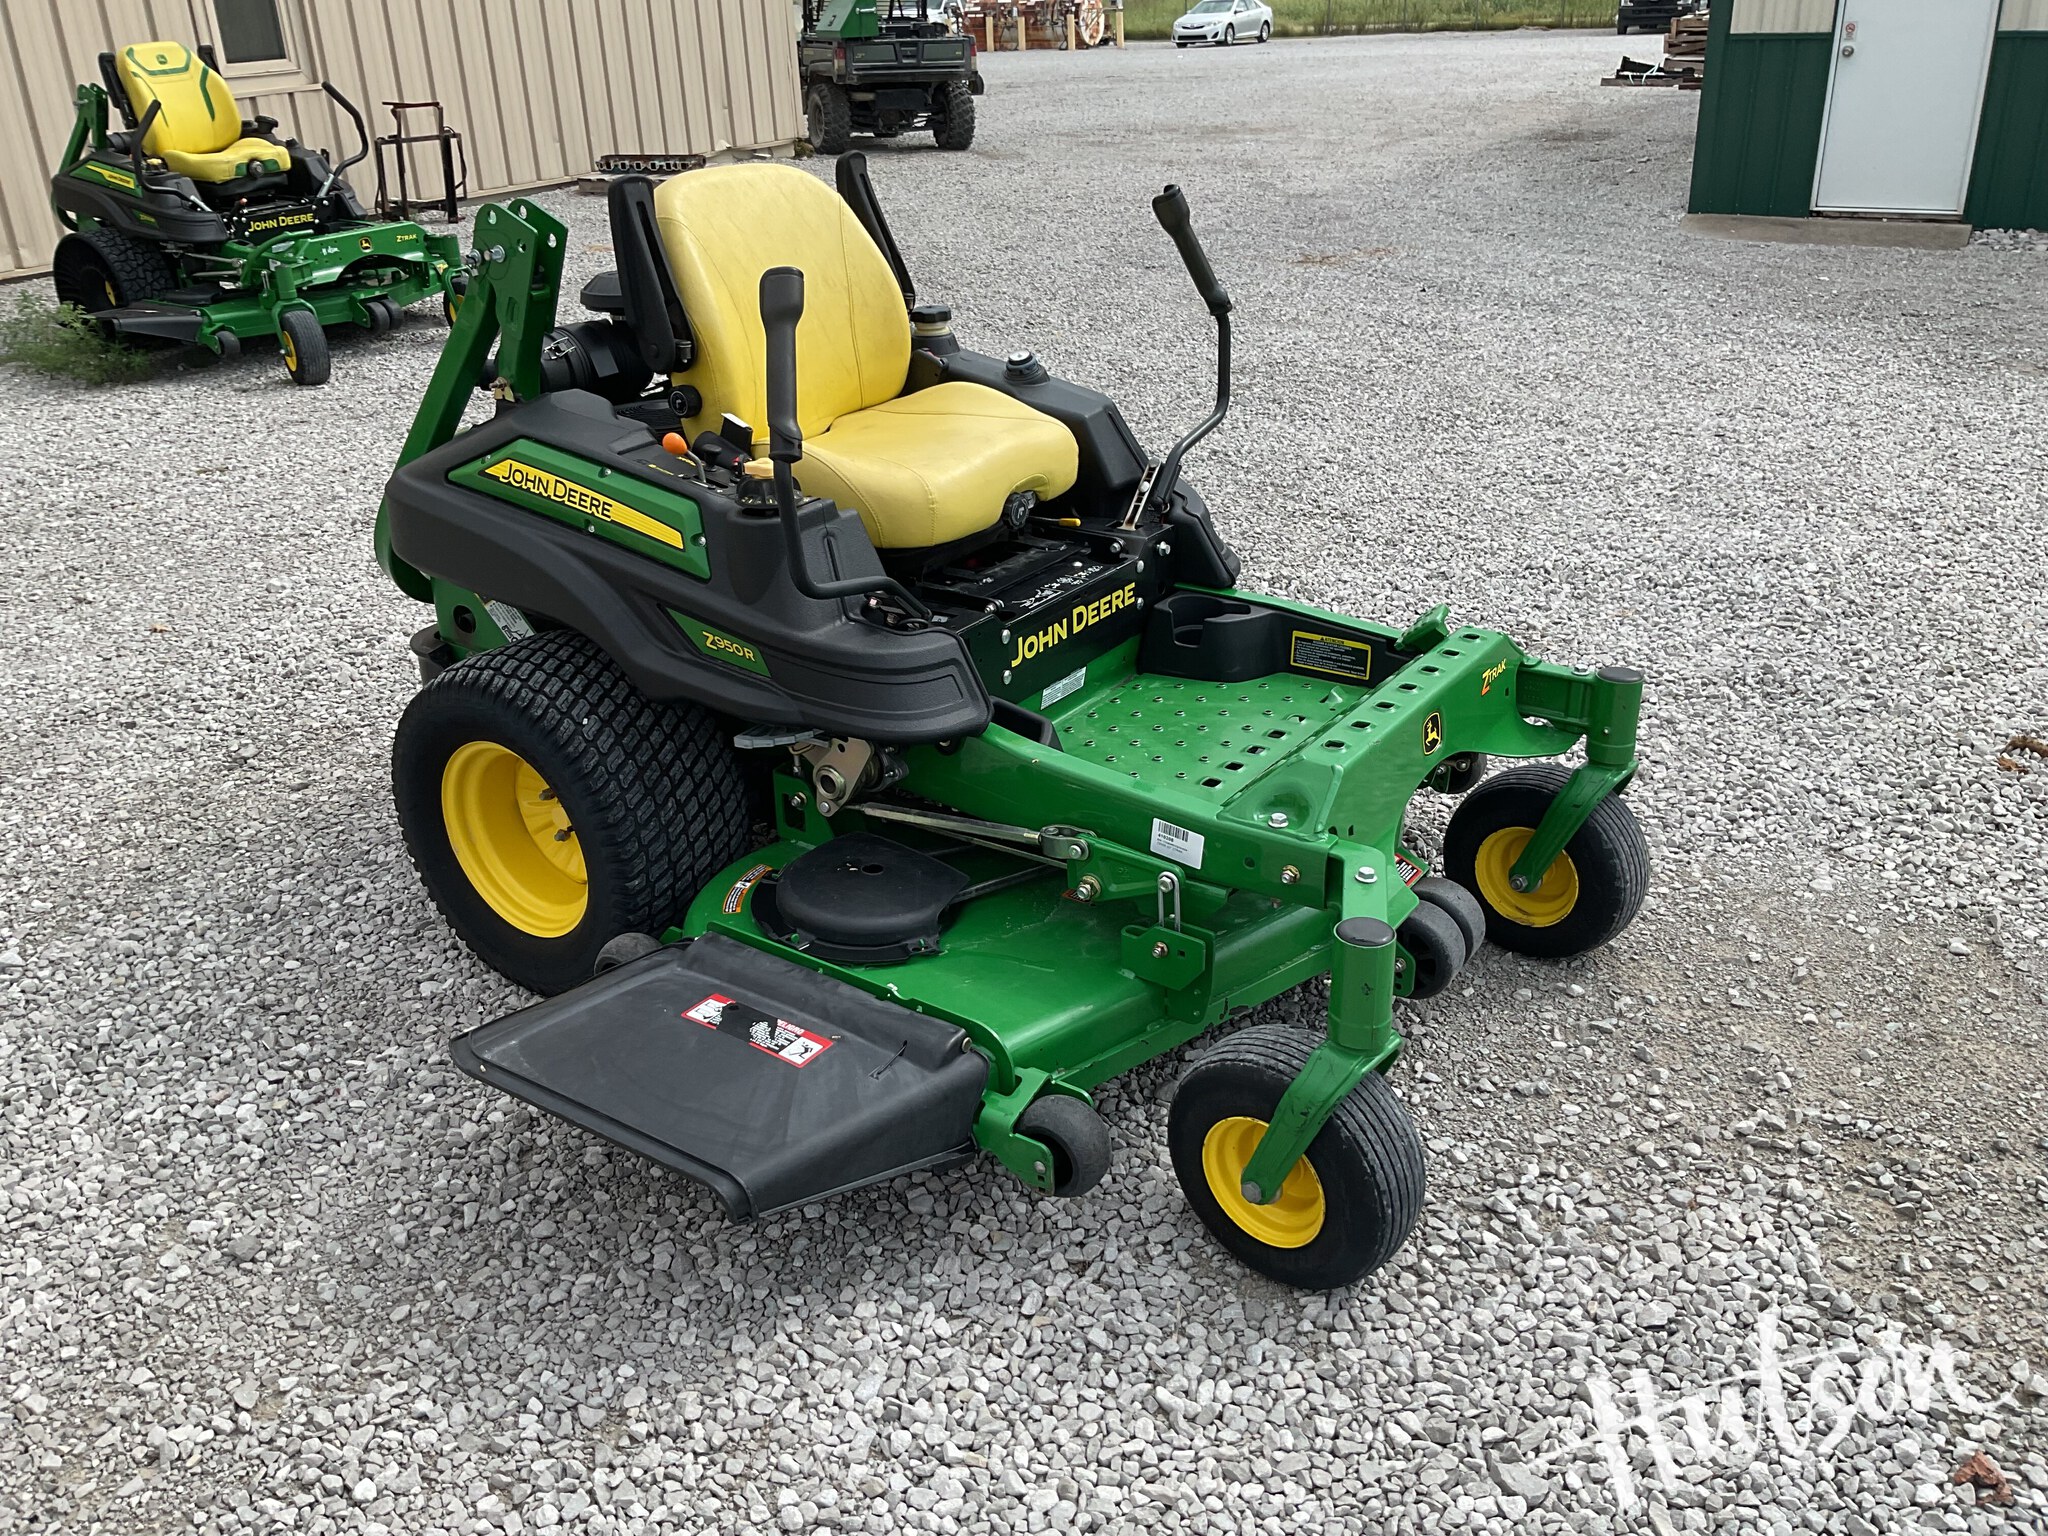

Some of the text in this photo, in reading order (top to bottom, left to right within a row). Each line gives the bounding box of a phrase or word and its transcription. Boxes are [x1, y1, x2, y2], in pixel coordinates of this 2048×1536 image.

[248, 213, 314, 232] JOHN DEERE
[396, 233, 417, 243] ZTRAK
[501, 463, 613, 519] JOHN DEERE
[1011, 582, 1136, 667] JOHN DEERE
[702, 631, 756, 662] Z950R
[1481, 658, 1507, 696] ZTRAK
